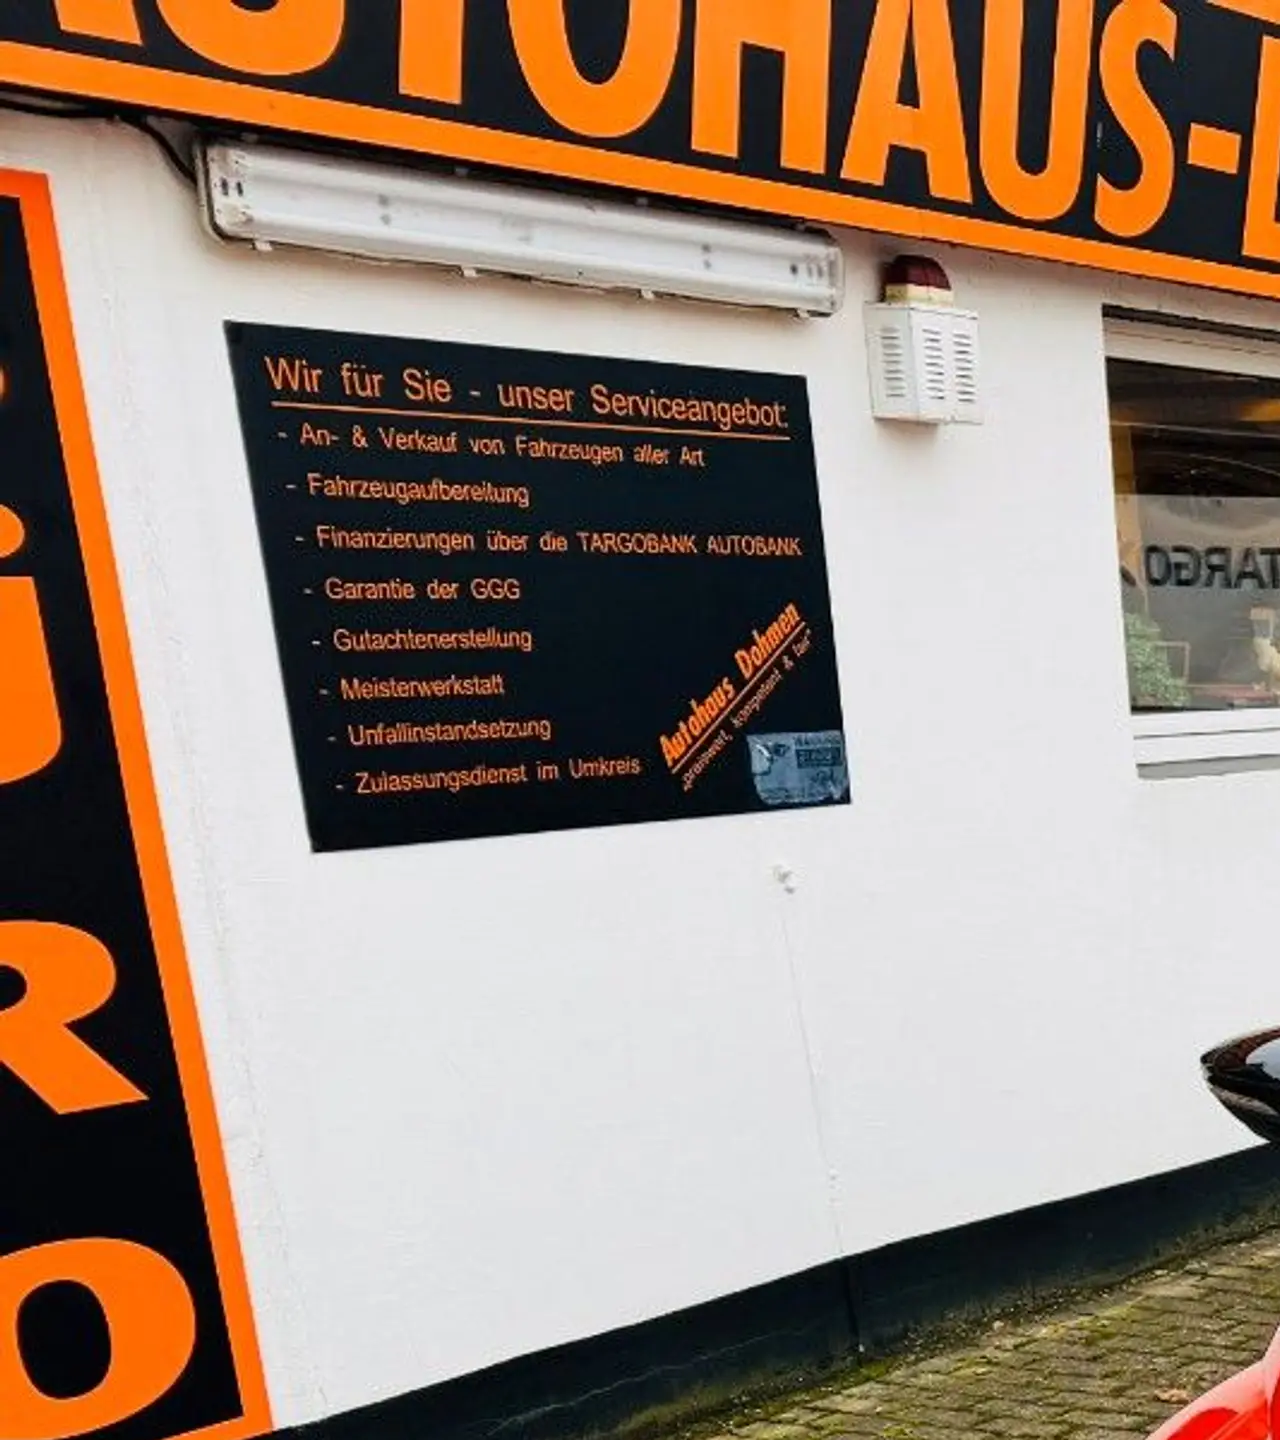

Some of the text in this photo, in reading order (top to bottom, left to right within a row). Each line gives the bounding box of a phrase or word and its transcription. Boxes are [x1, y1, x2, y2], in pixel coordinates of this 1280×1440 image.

[264, 356, 323, 393] Wir
[341, 363, 385, 398] für
[402, 368, 452, 402] Sie
[497, 384, 575, 412] unser
[590, 384, 789, 430] Serviceangebot:
[300, 422, 340, 446] An-
[352, 424, 369, 448] &
[378, 427, 458, 452] Verkauf
[469, 438, 506, 455] von
[515, 436, 624, 465] Fahrzeugen
[633, 445, 671, 465] aller
[679, 446, 705, 467] Art
[307, 472, 530, 508] Fahrzeugaufbereitung
[316, 525, 476, 556] Finanzierungen
[487, 528, 528, 551] über
[540, 531, 568, 551] die
[576, 532, 698, 554] TARGOBANK
[708, 535, 803, 556] AUTOBANK
[325, 577, 416, 600] Garantie
[427, 579, 459, 600] der
[470, 578, 521, 600] GGG
[333, 628, 533, 652] Gutachtenerstellung
[340, 674, 505, 700] Meisterwerkstatt
[659, 602, 801, 768] Autohaus Dohmen
[347, 719, 552, 746] Unfallinstandsetzung
[355, 763, 528, 795] Zulassungsdienst
[536, 762, 559, 780] im
[568, 756, 642, 779] Umkreis
